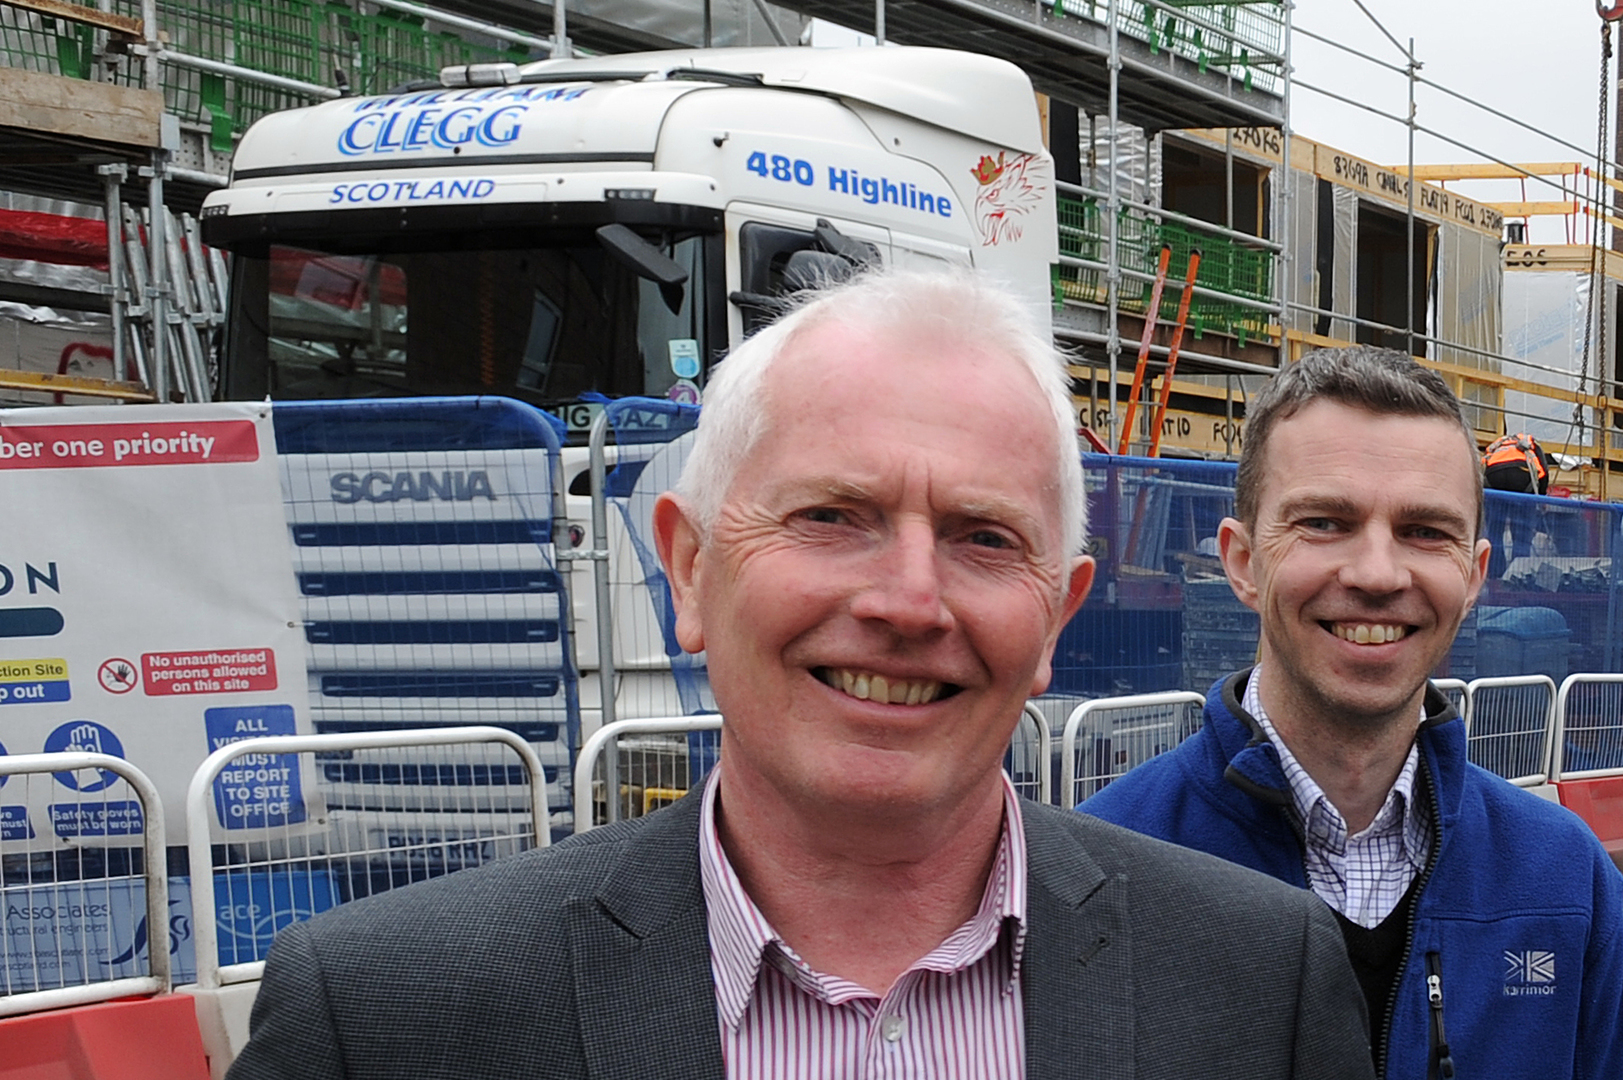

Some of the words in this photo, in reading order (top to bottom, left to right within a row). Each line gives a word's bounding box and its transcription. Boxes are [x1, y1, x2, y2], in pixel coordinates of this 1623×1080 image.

[338, 105, 529, 156] CLEGG
[330, 179, 496, 204] SCOTLAND
[747, 150, 814, 186] 480
[828, 166, 953, 218] Highline
[52, 440, 104, 457] one
[113, 431, 215, 461] priority
[330, 471, 498, 504] SCANIA
[150, 656, 170, 668] No
[174, 652, 266, 667] unauthorised
[35, 664, 64, 676] Site
[152, 668, 210, 682] persons
[213, 664, 267, 678] allowed
[13, 684, 45, 699] out
[172, 682, 191, 693] on
[194, 679, 220, 691] this
[223, 679, 249, 690] site
[235, 719, 268, 732] ALL
[231, 753, 277, 767] MUST
[221, 768, 291, 784] REPORT
[226, 786, 250, 800] TO
[253, 785, 291, 799] SITE
[54, 808, 95, 821] Safety
[231, 801, 291, 817] OFFICE
[57, 820, 90, 831] must
[92, 819, 106, 830] be
[109, 819, 142, 829] worn
[219, 903, 262, 920] ace
